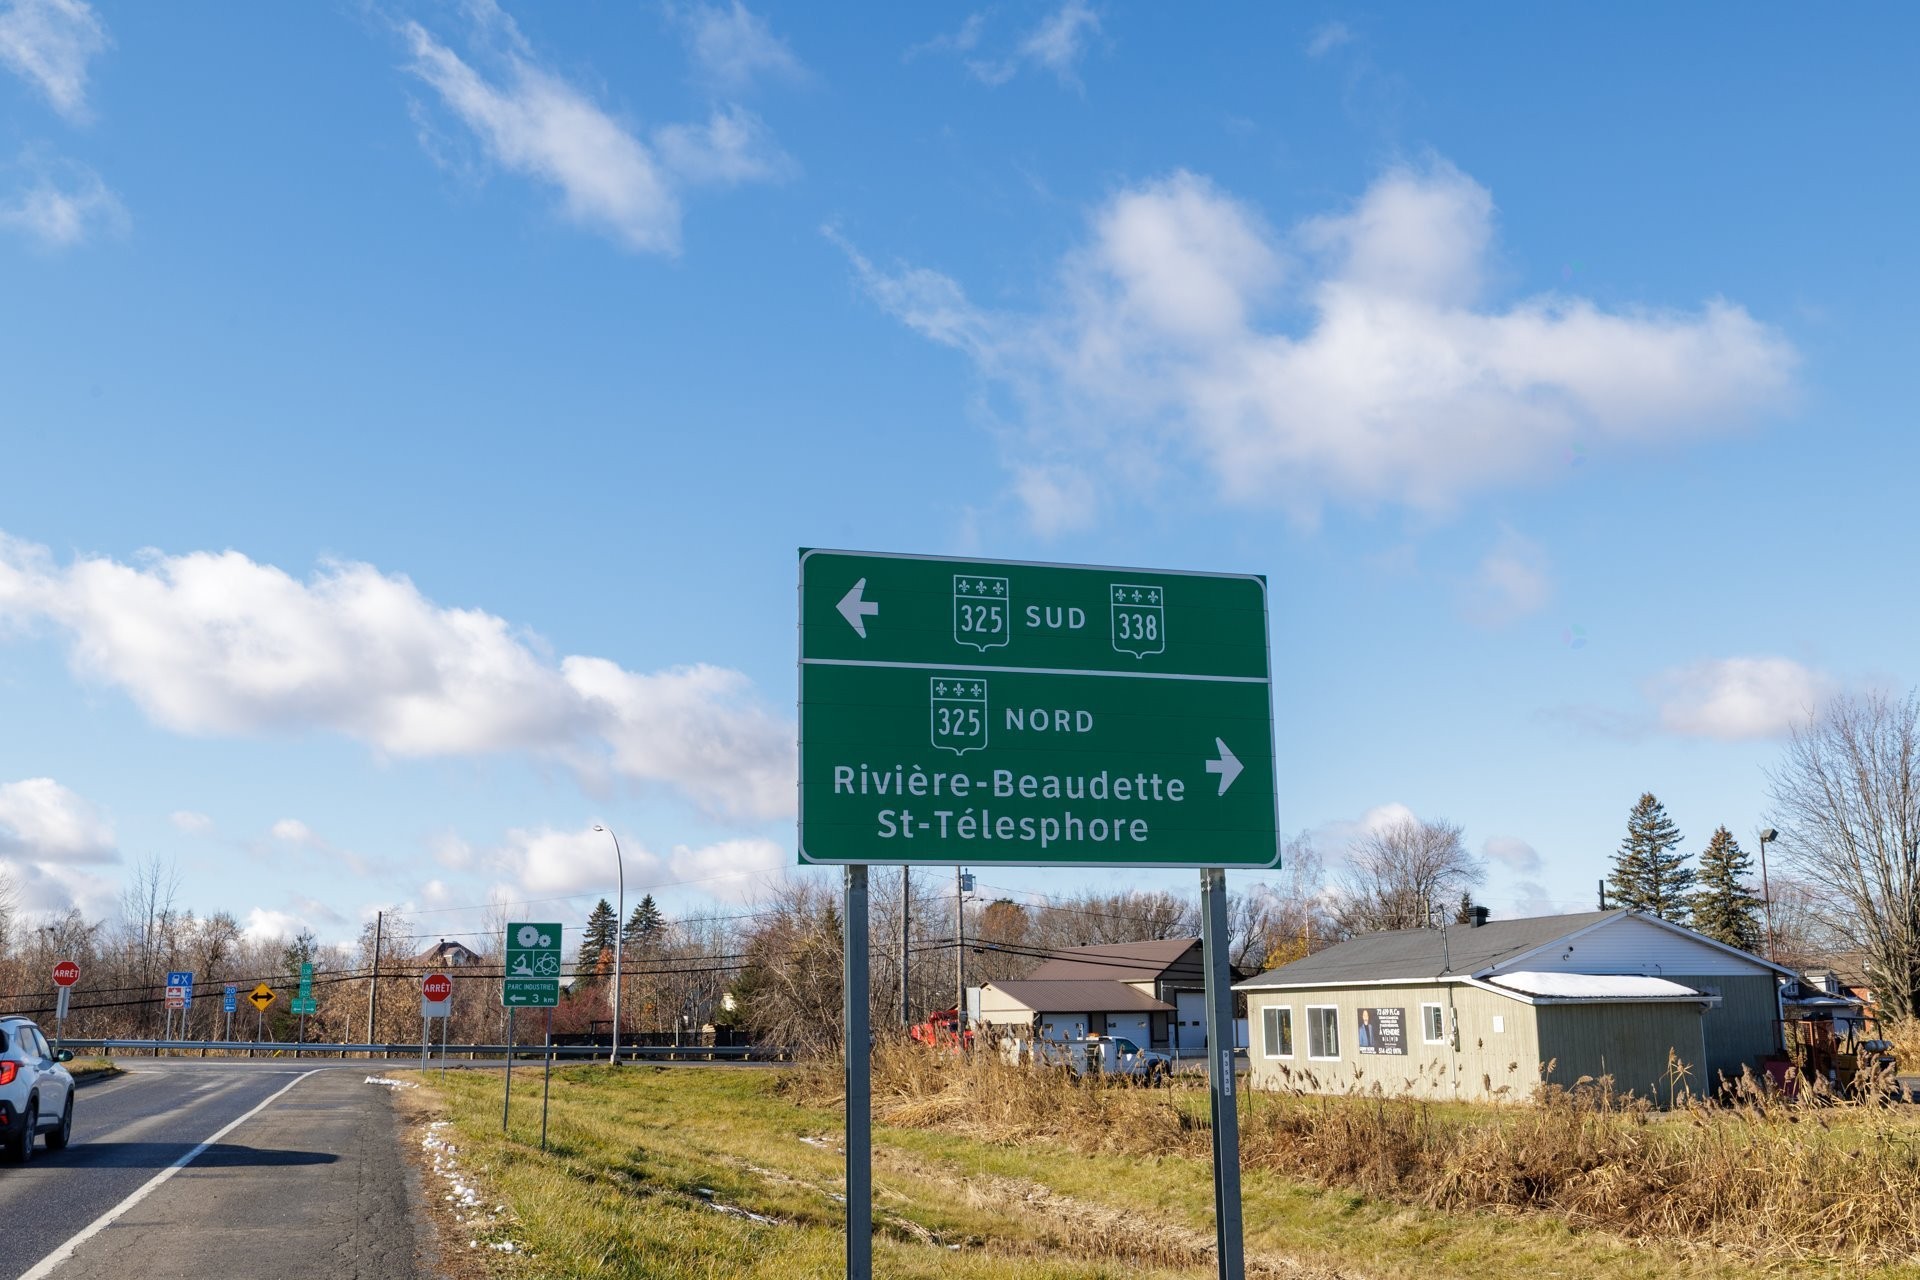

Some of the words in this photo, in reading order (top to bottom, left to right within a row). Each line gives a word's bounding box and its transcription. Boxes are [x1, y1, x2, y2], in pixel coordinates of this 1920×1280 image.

[961, 604, 1003, 634] 325
[1026, 605, 1086, 629] SUD
[1118, 613, 1158, 641] 338
[938, 707, 980, 737] 325
[1005, 708, 1094, 733] NORD
[833, 763, 1185, 803] Rivière-Beaudette
[876, 807, 1148, 849] St-Télesphore
[55, 969, 78, 977] ARRÊT
[424, 982, 451, 993] ARRÊT
[507, 983, 522, 991] PARC
[523, 983, 555, 992] INDUSTRIEL
[532, 994, 539, 1003] 3
